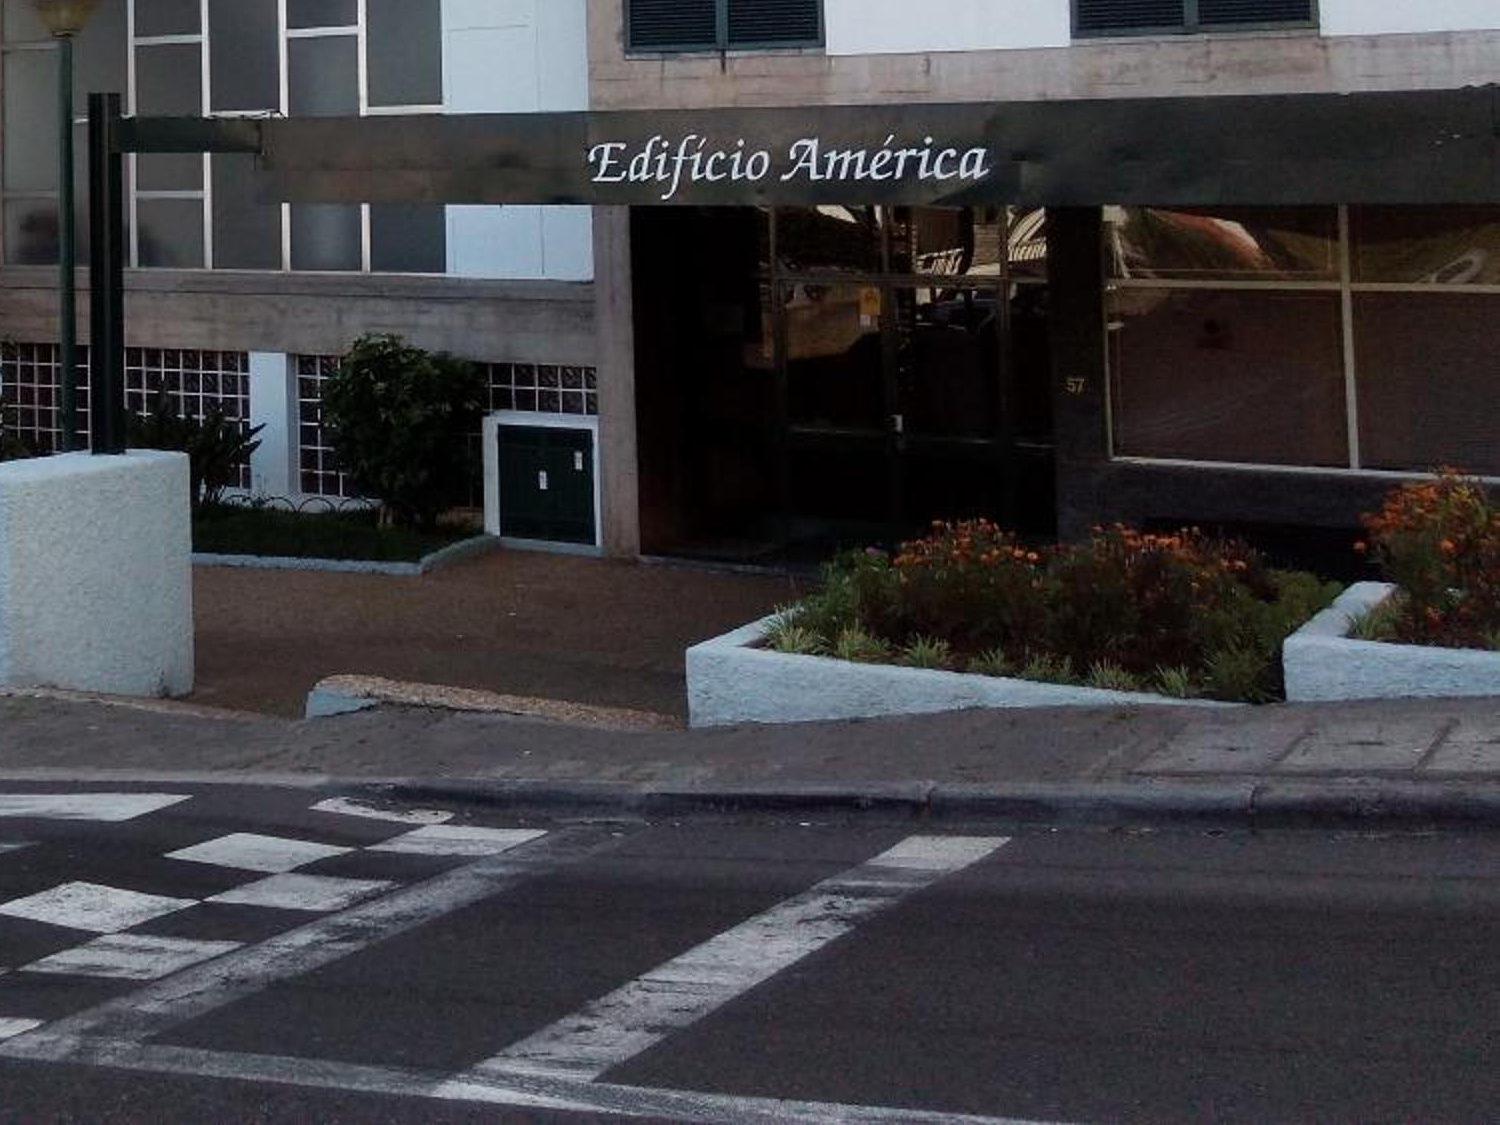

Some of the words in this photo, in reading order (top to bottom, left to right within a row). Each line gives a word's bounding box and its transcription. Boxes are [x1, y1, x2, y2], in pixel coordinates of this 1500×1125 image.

[588, 134, 771, 200] Edifício
[780, 134, 990, 181] América
[1066, 378, 1085, 394] 57
